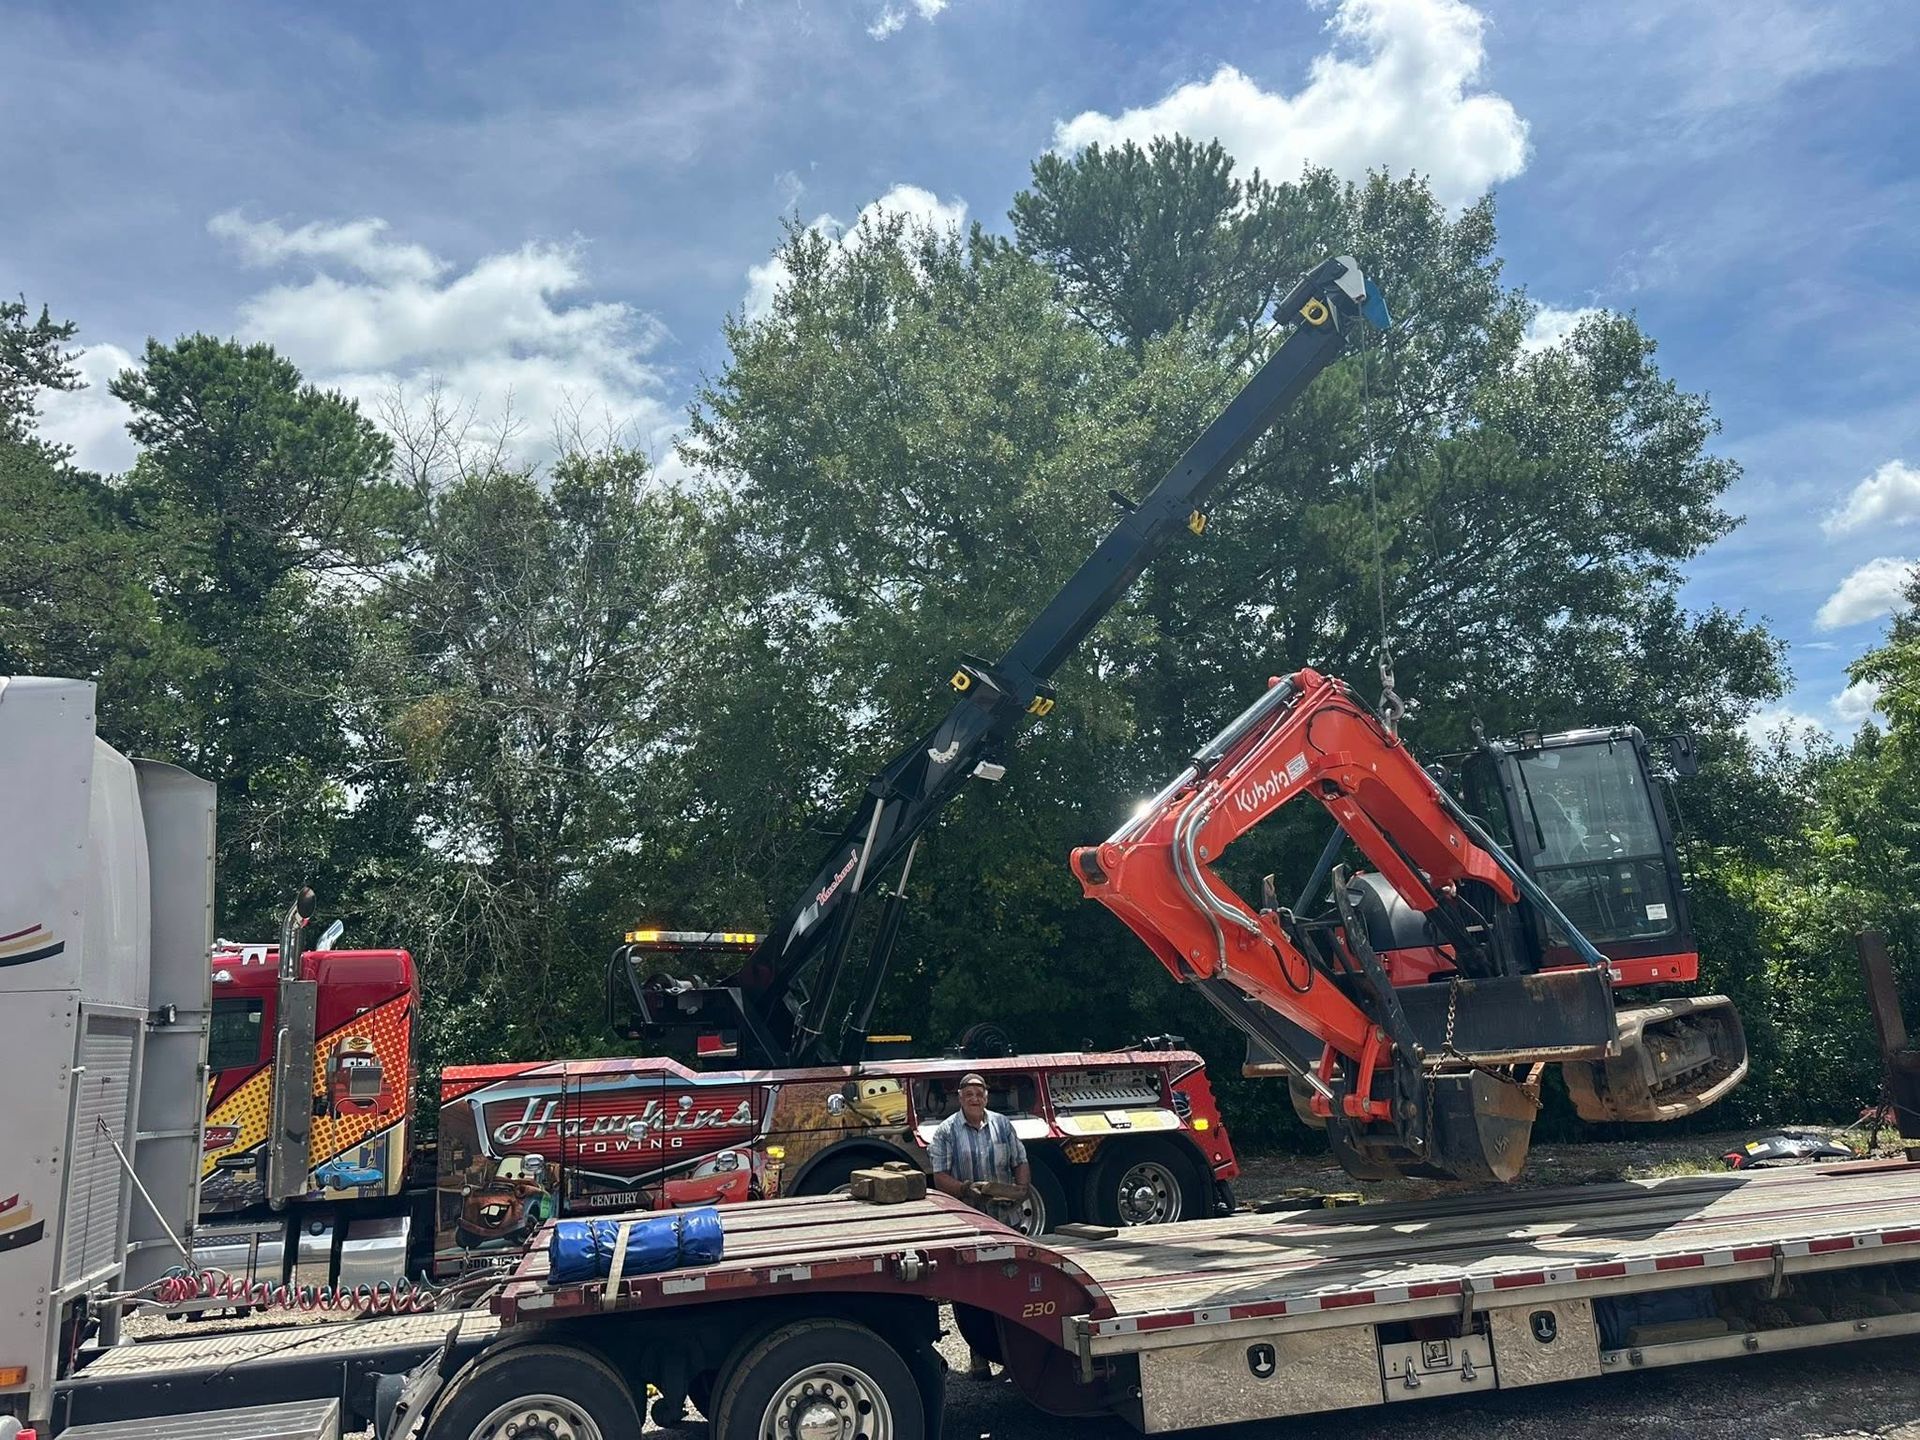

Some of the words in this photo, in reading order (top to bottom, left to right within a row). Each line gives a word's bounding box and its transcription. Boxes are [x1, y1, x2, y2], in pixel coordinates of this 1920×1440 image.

[1234, 769, 1290, 813] Kubota
[493, 1095, 759, 1145] Hawkins
[576, 1137, 683, 1154] TOWING
[590, 1192, 638, 1207] CENTURY
[1022, 1301, 1056, 1318] 230
